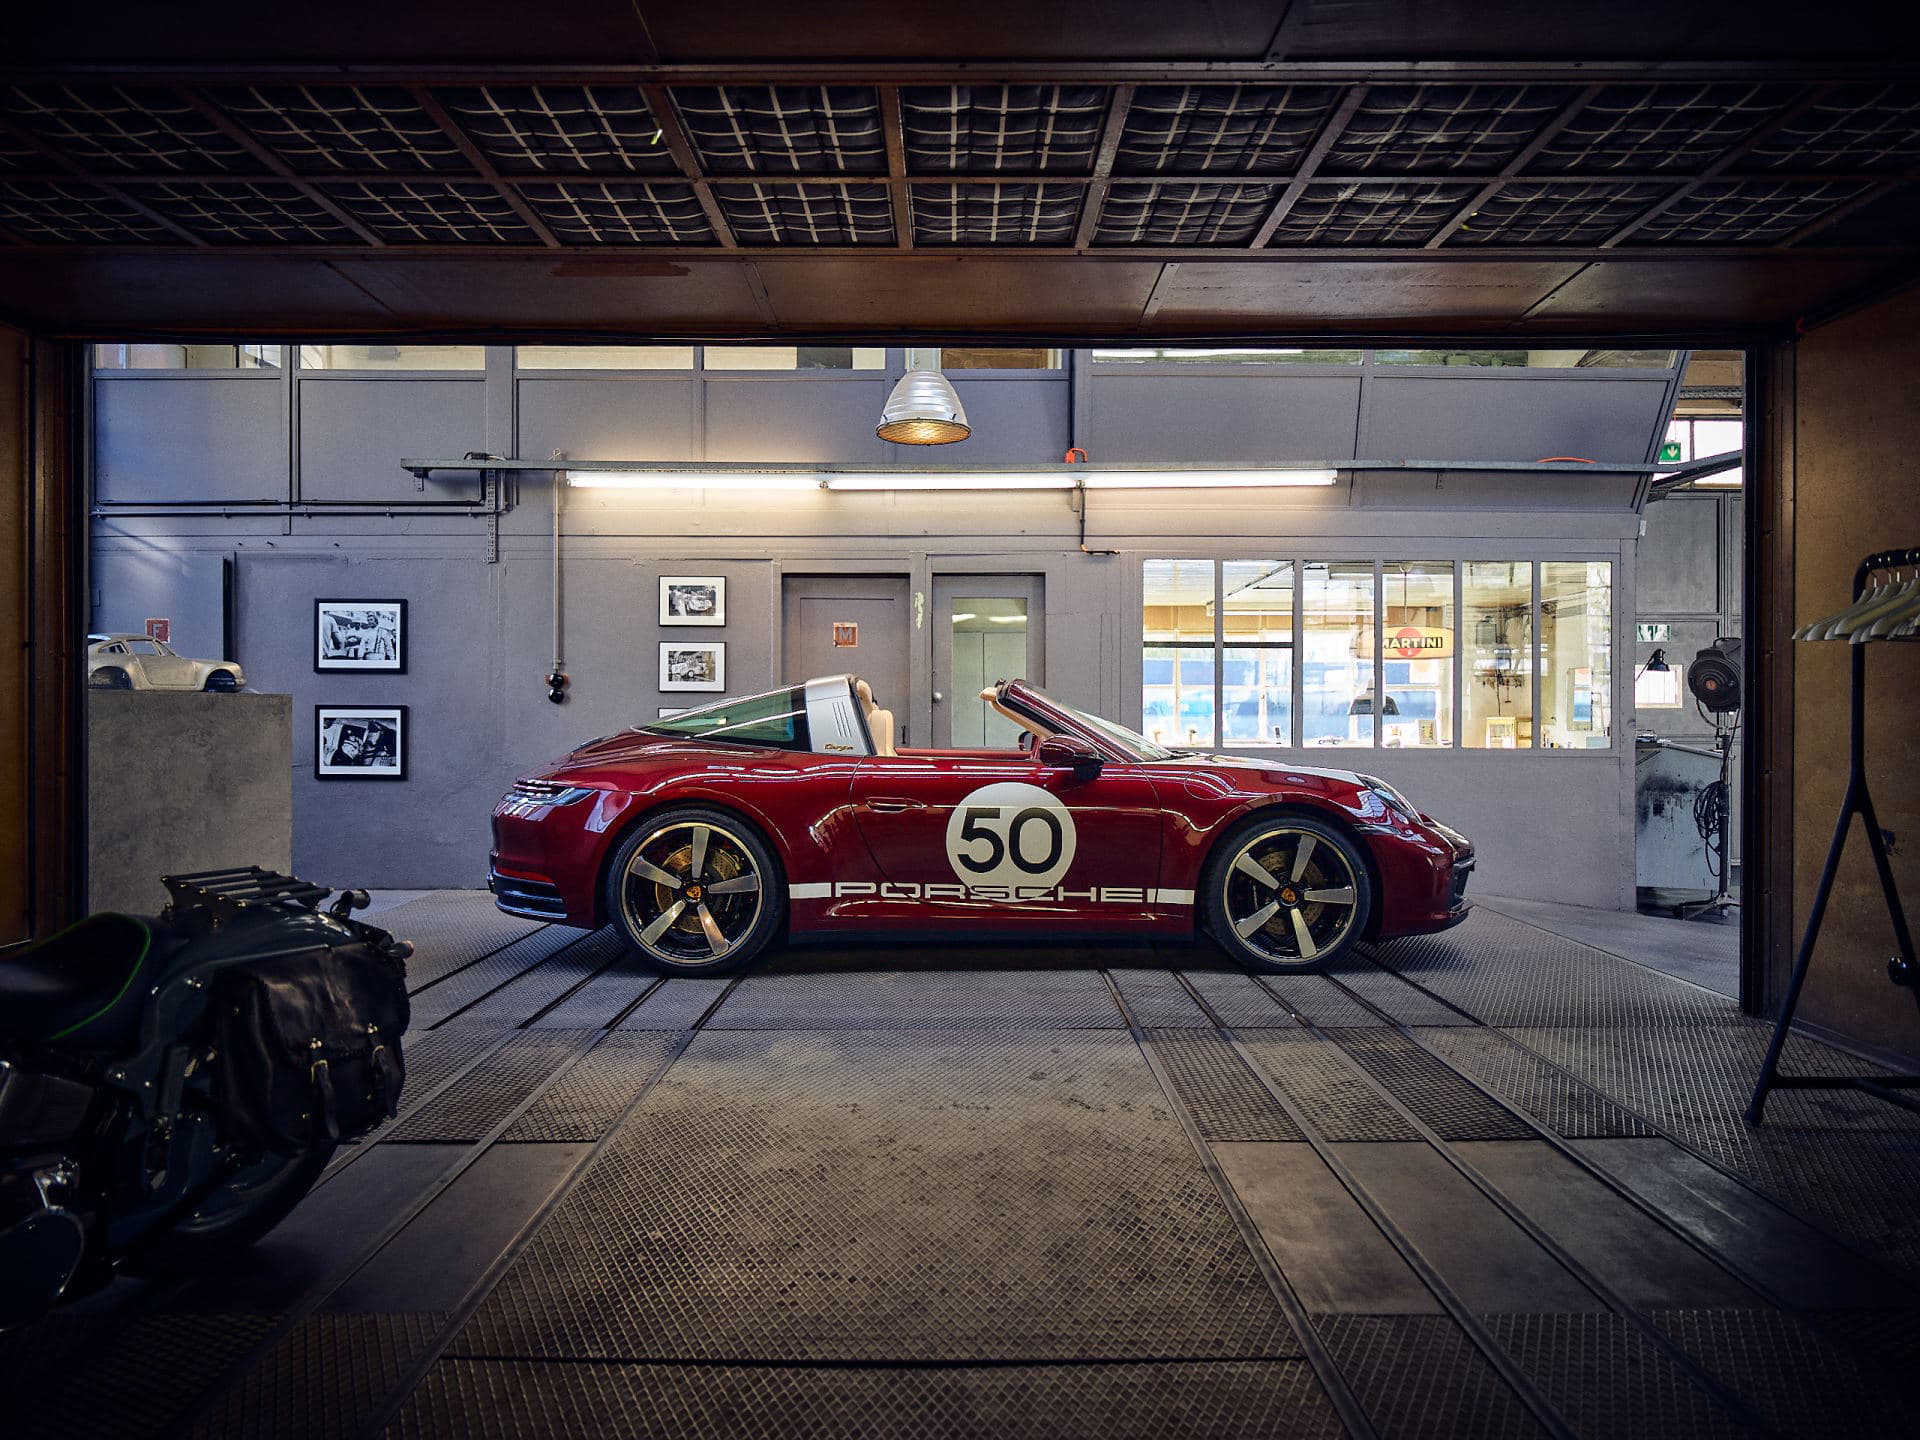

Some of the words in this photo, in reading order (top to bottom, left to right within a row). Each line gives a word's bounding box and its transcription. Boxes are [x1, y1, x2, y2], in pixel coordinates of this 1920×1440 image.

[838, 627, 853, 643] M
[957, 807, 1063, 875] 50
[834, 881, 1143, 902] PORSCHE
